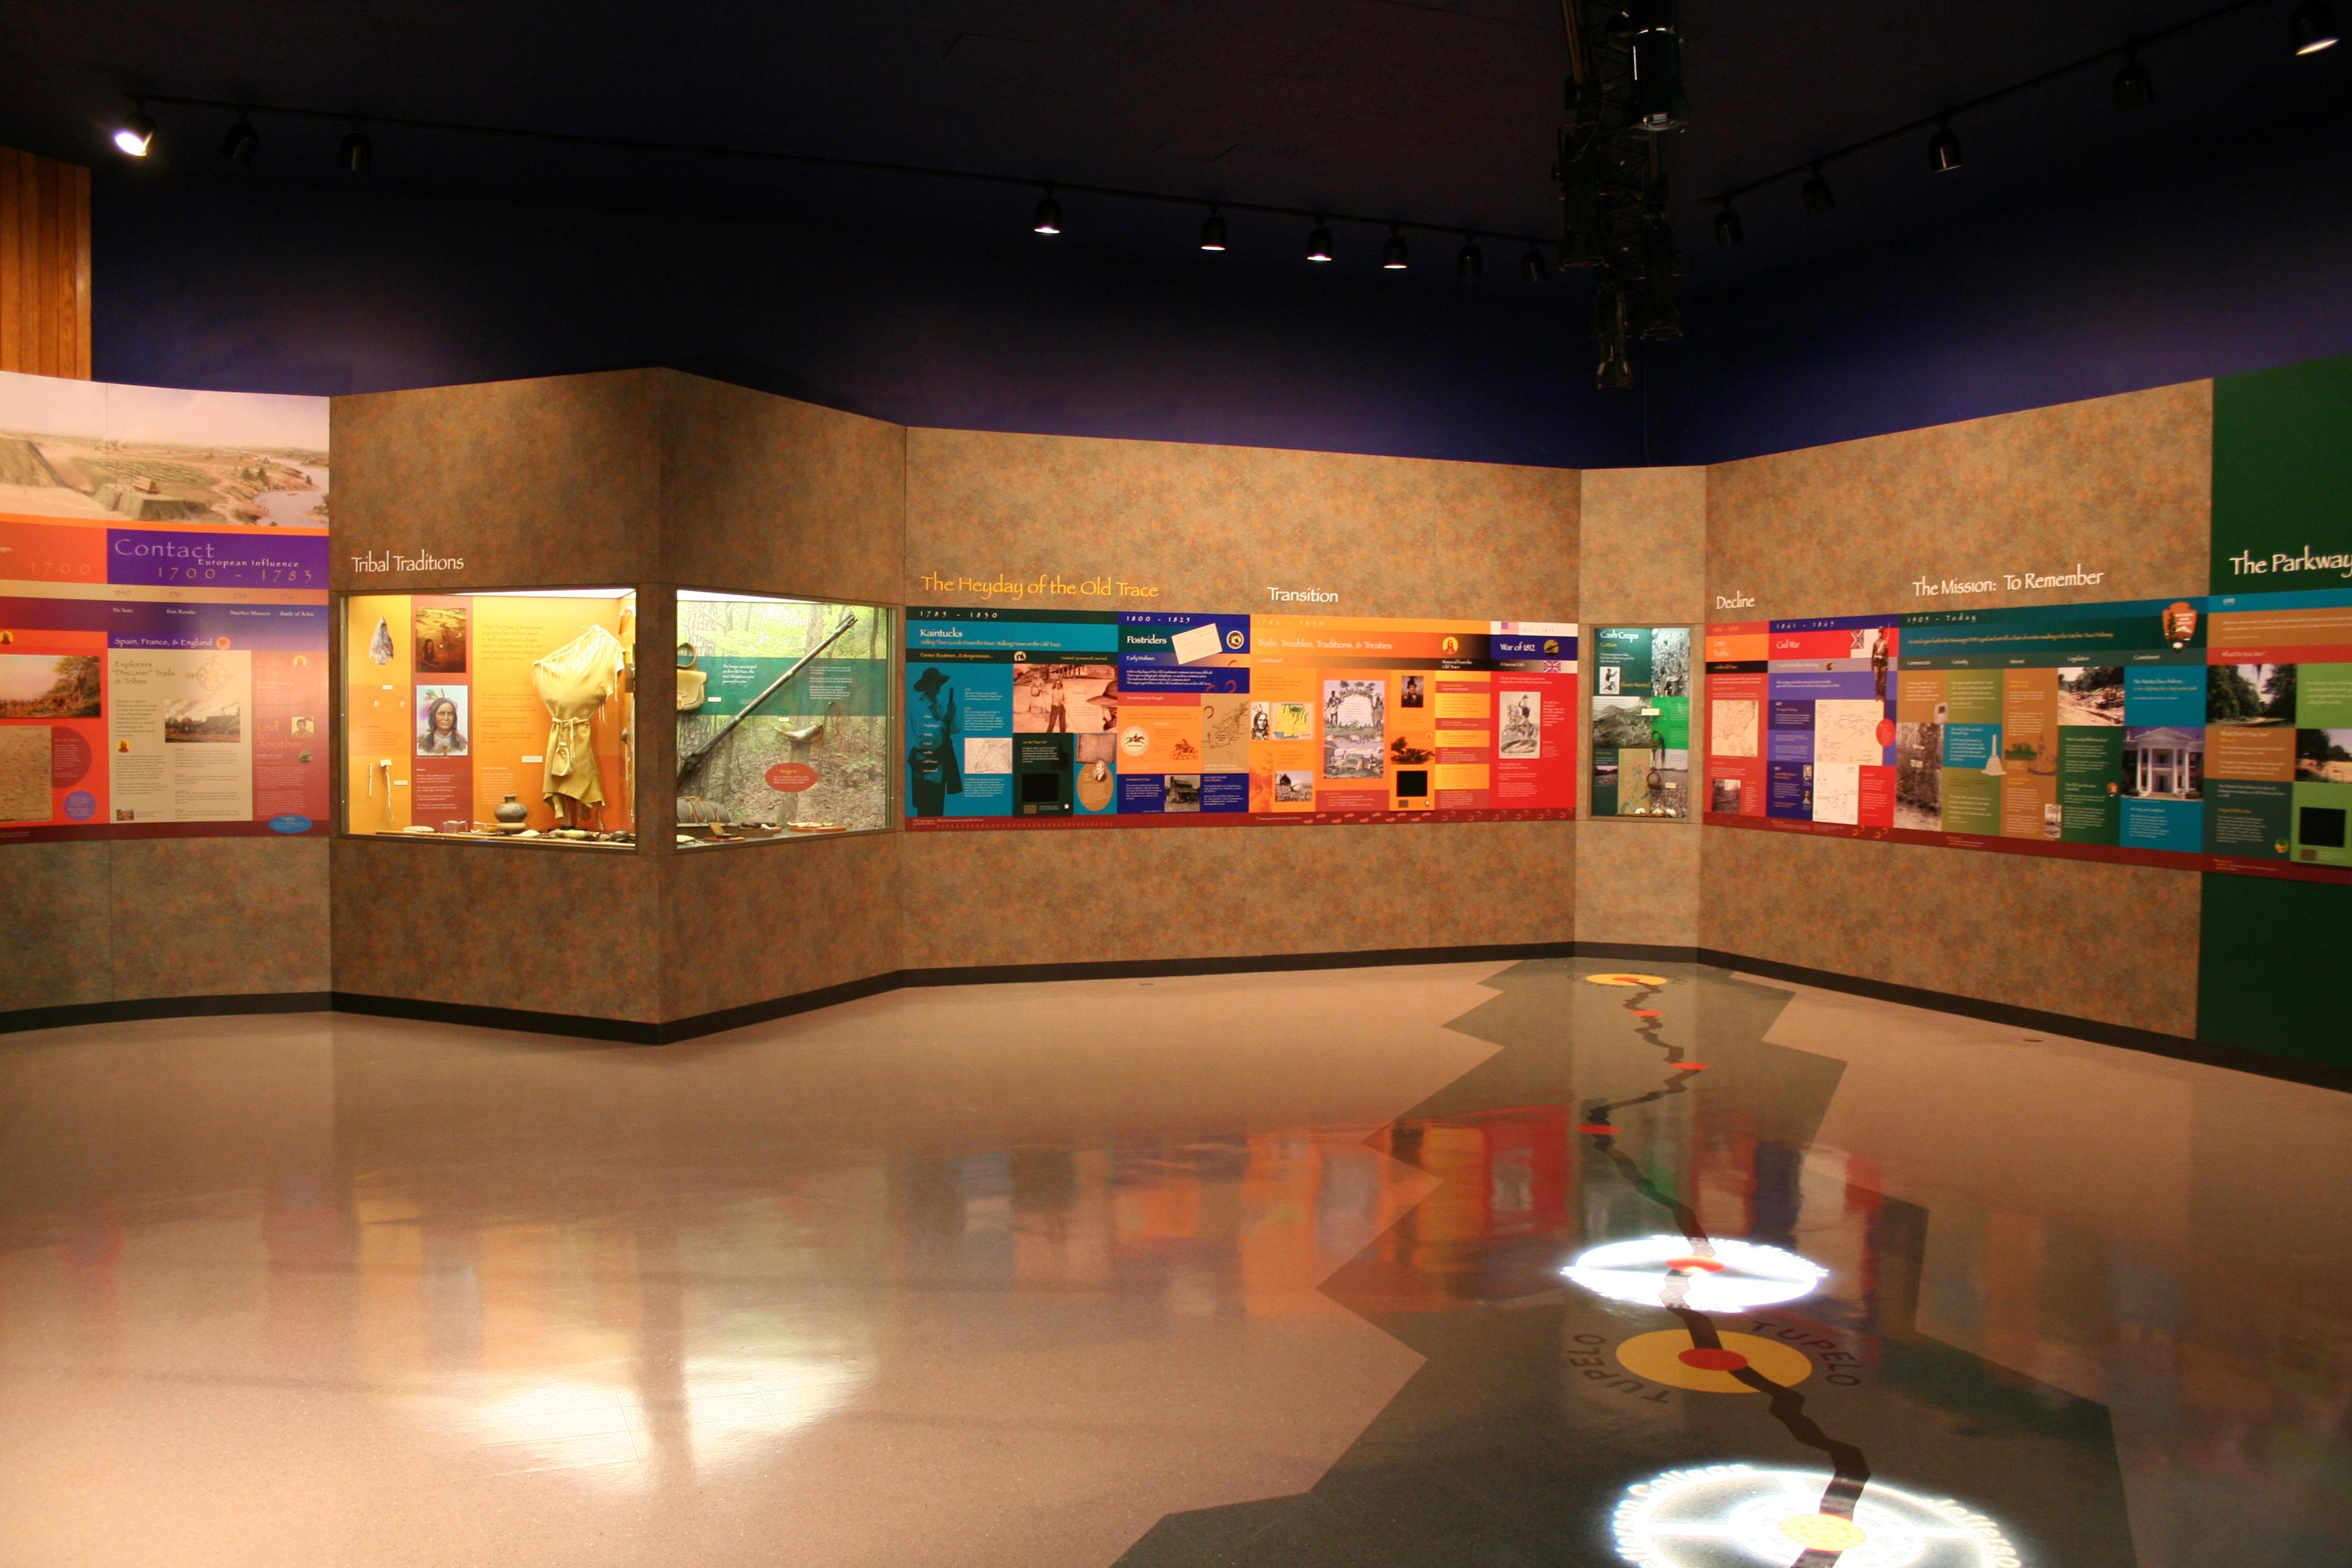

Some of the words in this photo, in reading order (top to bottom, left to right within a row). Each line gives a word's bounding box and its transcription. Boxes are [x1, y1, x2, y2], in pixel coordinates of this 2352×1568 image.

[115, 539, 216, 559] Contact
[198, 558, 247, 568] European
[251, 559, 299, 568] Influence
[350, 550, 390, 573] Tribal
[393, 549, 465, 572] Traditions
[2229, 549, 2268, 575] The
[2272, 544, 2352, 578] Parkway
[157, 567, 216, 581] 1700
[261, 570, 312, 584] 1783
[1912, 576, 1938, 596] The
[1941, 578, 1997, 595] Mission:
[2003, 574, 2021, 591] To
[2025, 564, 2104, 589] Remember
[921, 572, 954, 591] The
[958, 573, 1024, 602] Heyday
[1027, 574, 1047, 594] of
[1050, 575, 1077, 595] the
[1080, 576, 1111, 597] Old
[1115, 581, 1159, 598] Trace
[1267, 587, 1339, 603] Transition
[1716, 590, 1754, 609] Decline
[1946, 612, 1976, 623] Today
[920, 627, 963, 638] Kaintucks
[1127, 634, 1167, 644] Postriders
[1600, 630, 1617, 638] Cash
[1618, 632, 1639, 643] Crops
[114, 637, 139, 647] Spain,
[141, 638, 170, 646] France,
[180, 637, 212, 649] England
[1280, 637, 1315, 649] Troubles,
[1316, 638, 1354, 650] Traditions,
[1363, 641, 1392, 650] Treaties
[1499, 643, 1514, 651] War
[1514, 641, 1523, 651] of
[1753, 1320, 1862, 1386] TUPELO
[1567, 1334, 1670, 1404] TUPELO
